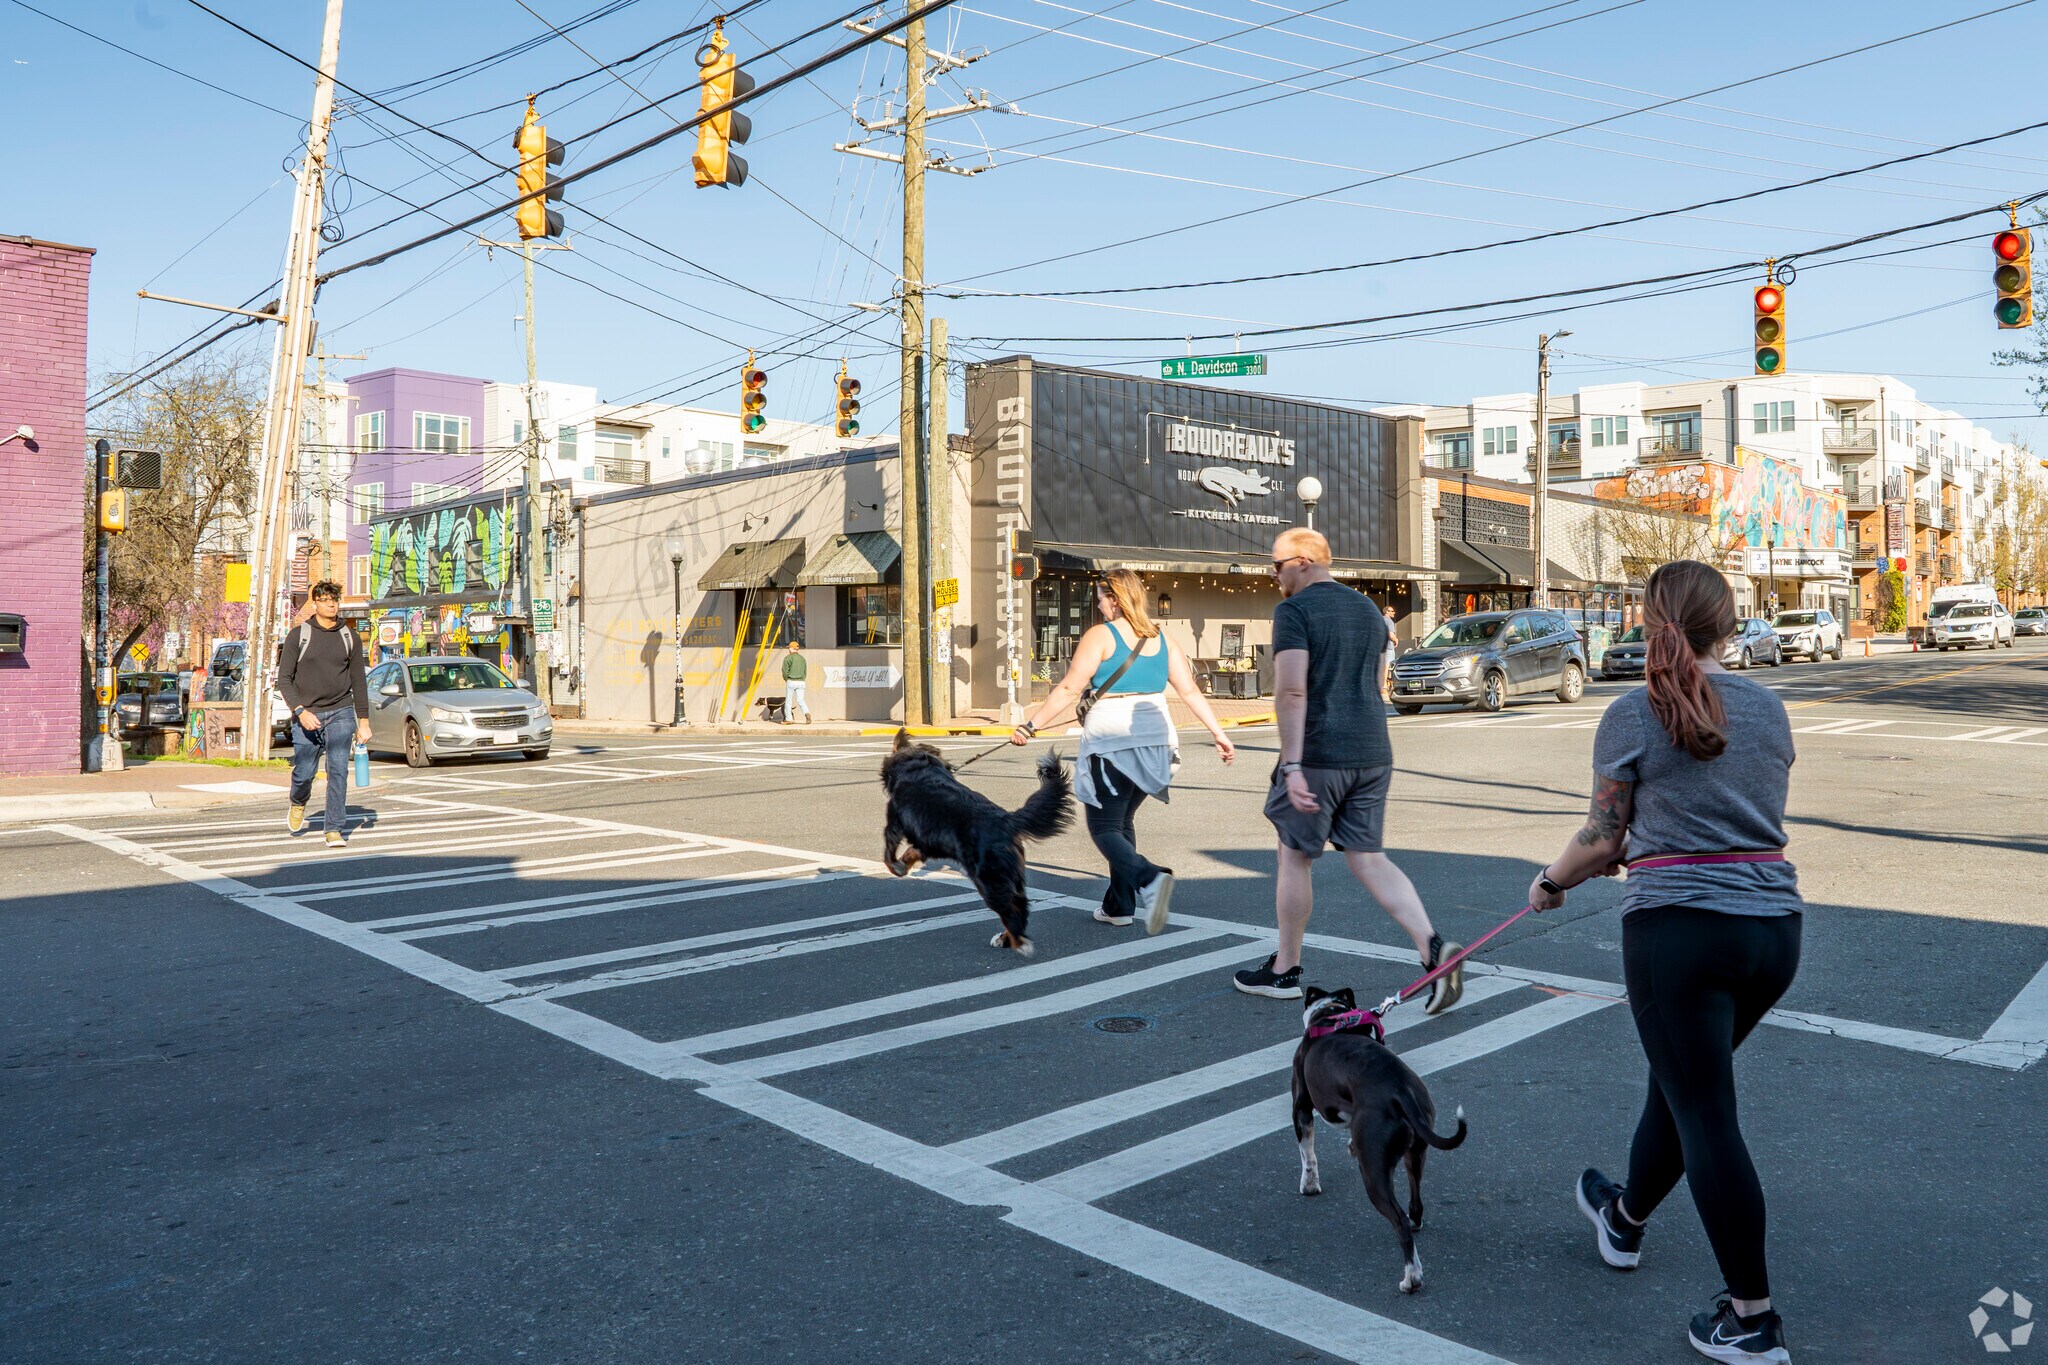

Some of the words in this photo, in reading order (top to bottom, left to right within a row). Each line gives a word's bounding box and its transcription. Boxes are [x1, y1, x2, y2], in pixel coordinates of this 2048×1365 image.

[1177, 361, 1187, 375] N.
[1191, 360, 1238, 375] Davidson
[1245, 365, 1262, 375] 3300
[1171, 424, 1295, 466] BOUDREAUX'S
[1178, 469, 1196, 482] NODA
[1187, 509, 1231, 522] KITCHEN
[1232, 513, 1241, 522] &
[1243, 514, 1279, 525] TAVERN
[1794, 558, 1825, 566] HANCOCK
[935, 581, 945, 589] WE
[946, 579, 958, 587] BUY
[936, 586, 959, 596] HOUSES
